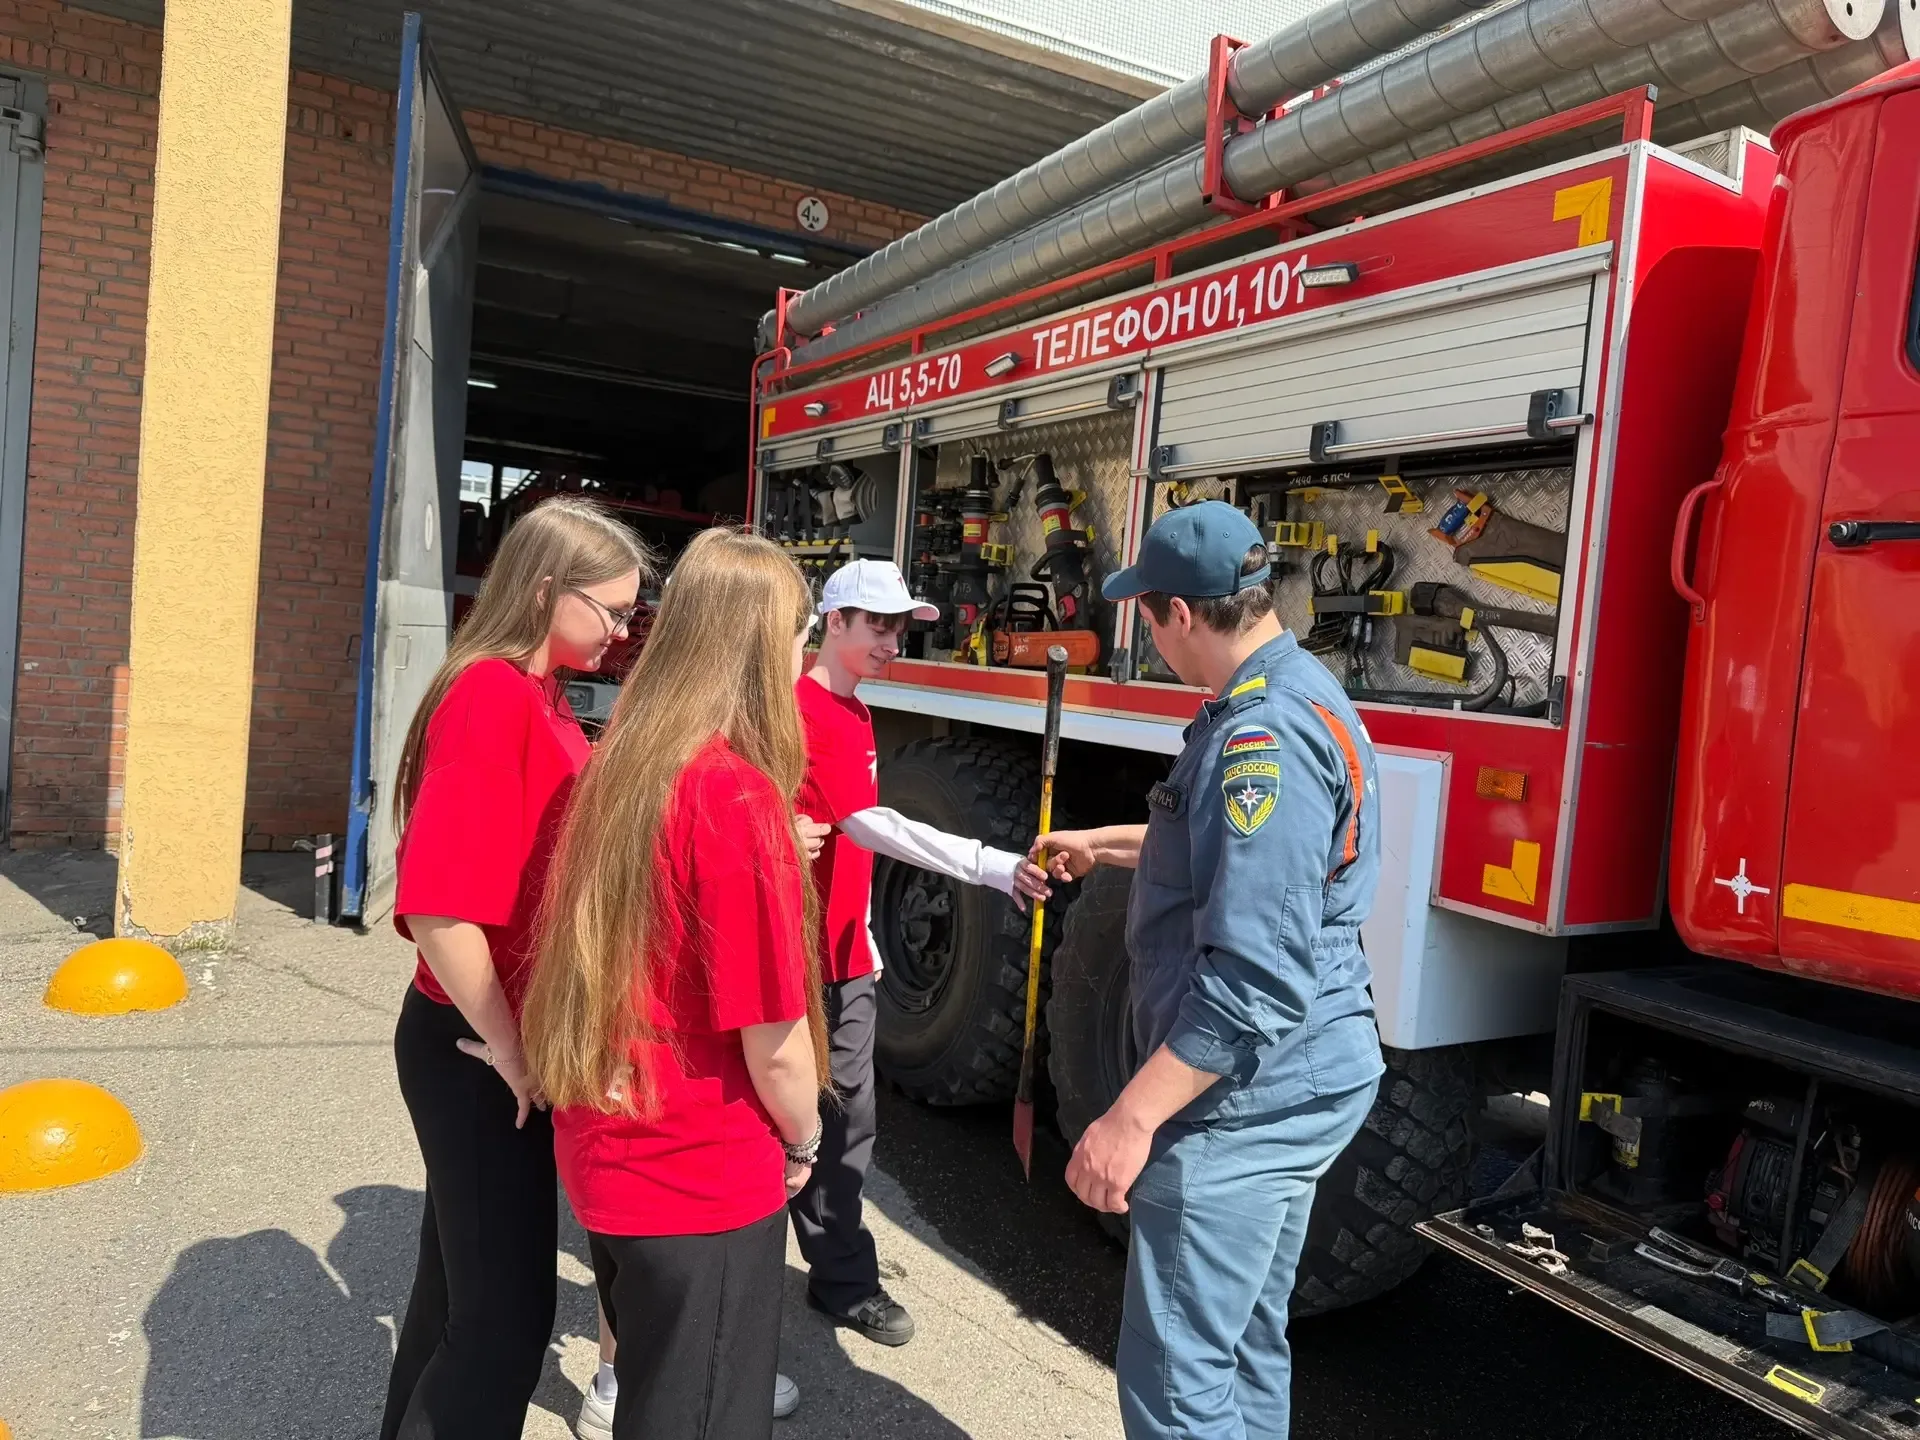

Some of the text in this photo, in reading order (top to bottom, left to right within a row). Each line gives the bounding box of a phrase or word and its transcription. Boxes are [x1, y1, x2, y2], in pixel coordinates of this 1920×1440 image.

[1032, 286, 1198, 370] ТЕЛЕФОН
[865, 353, 961, 411] АЦ 5,5-70
[1233, 741, 1266, 751] РОССИЯ
[1226, 763, 1278, 780] МЧС РОССИИ
